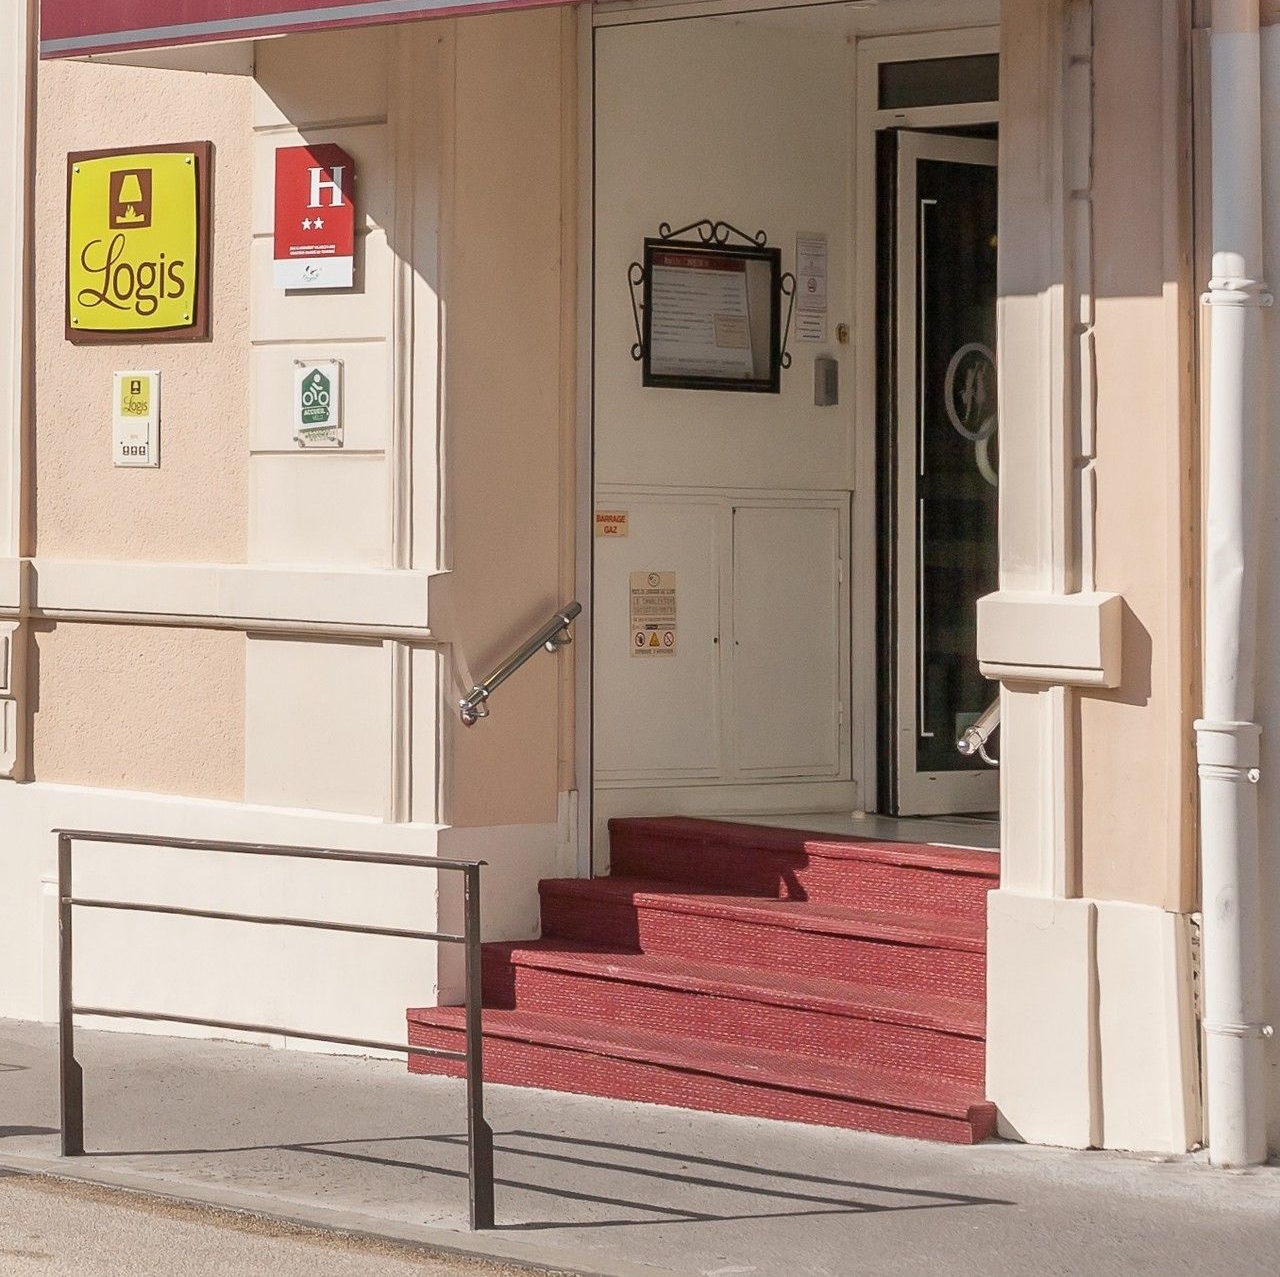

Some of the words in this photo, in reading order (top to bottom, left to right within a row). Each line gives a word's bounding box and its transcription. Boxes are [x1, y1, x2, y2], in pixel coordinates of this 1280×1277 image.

[306, 165, 347, 208] H
[77, 233, 185, 316] Logis
[122, 395, 148, 415] Logis
[596, 514, 627, 523] BARRAGE
[603, 526, 618, 534] GAZ
